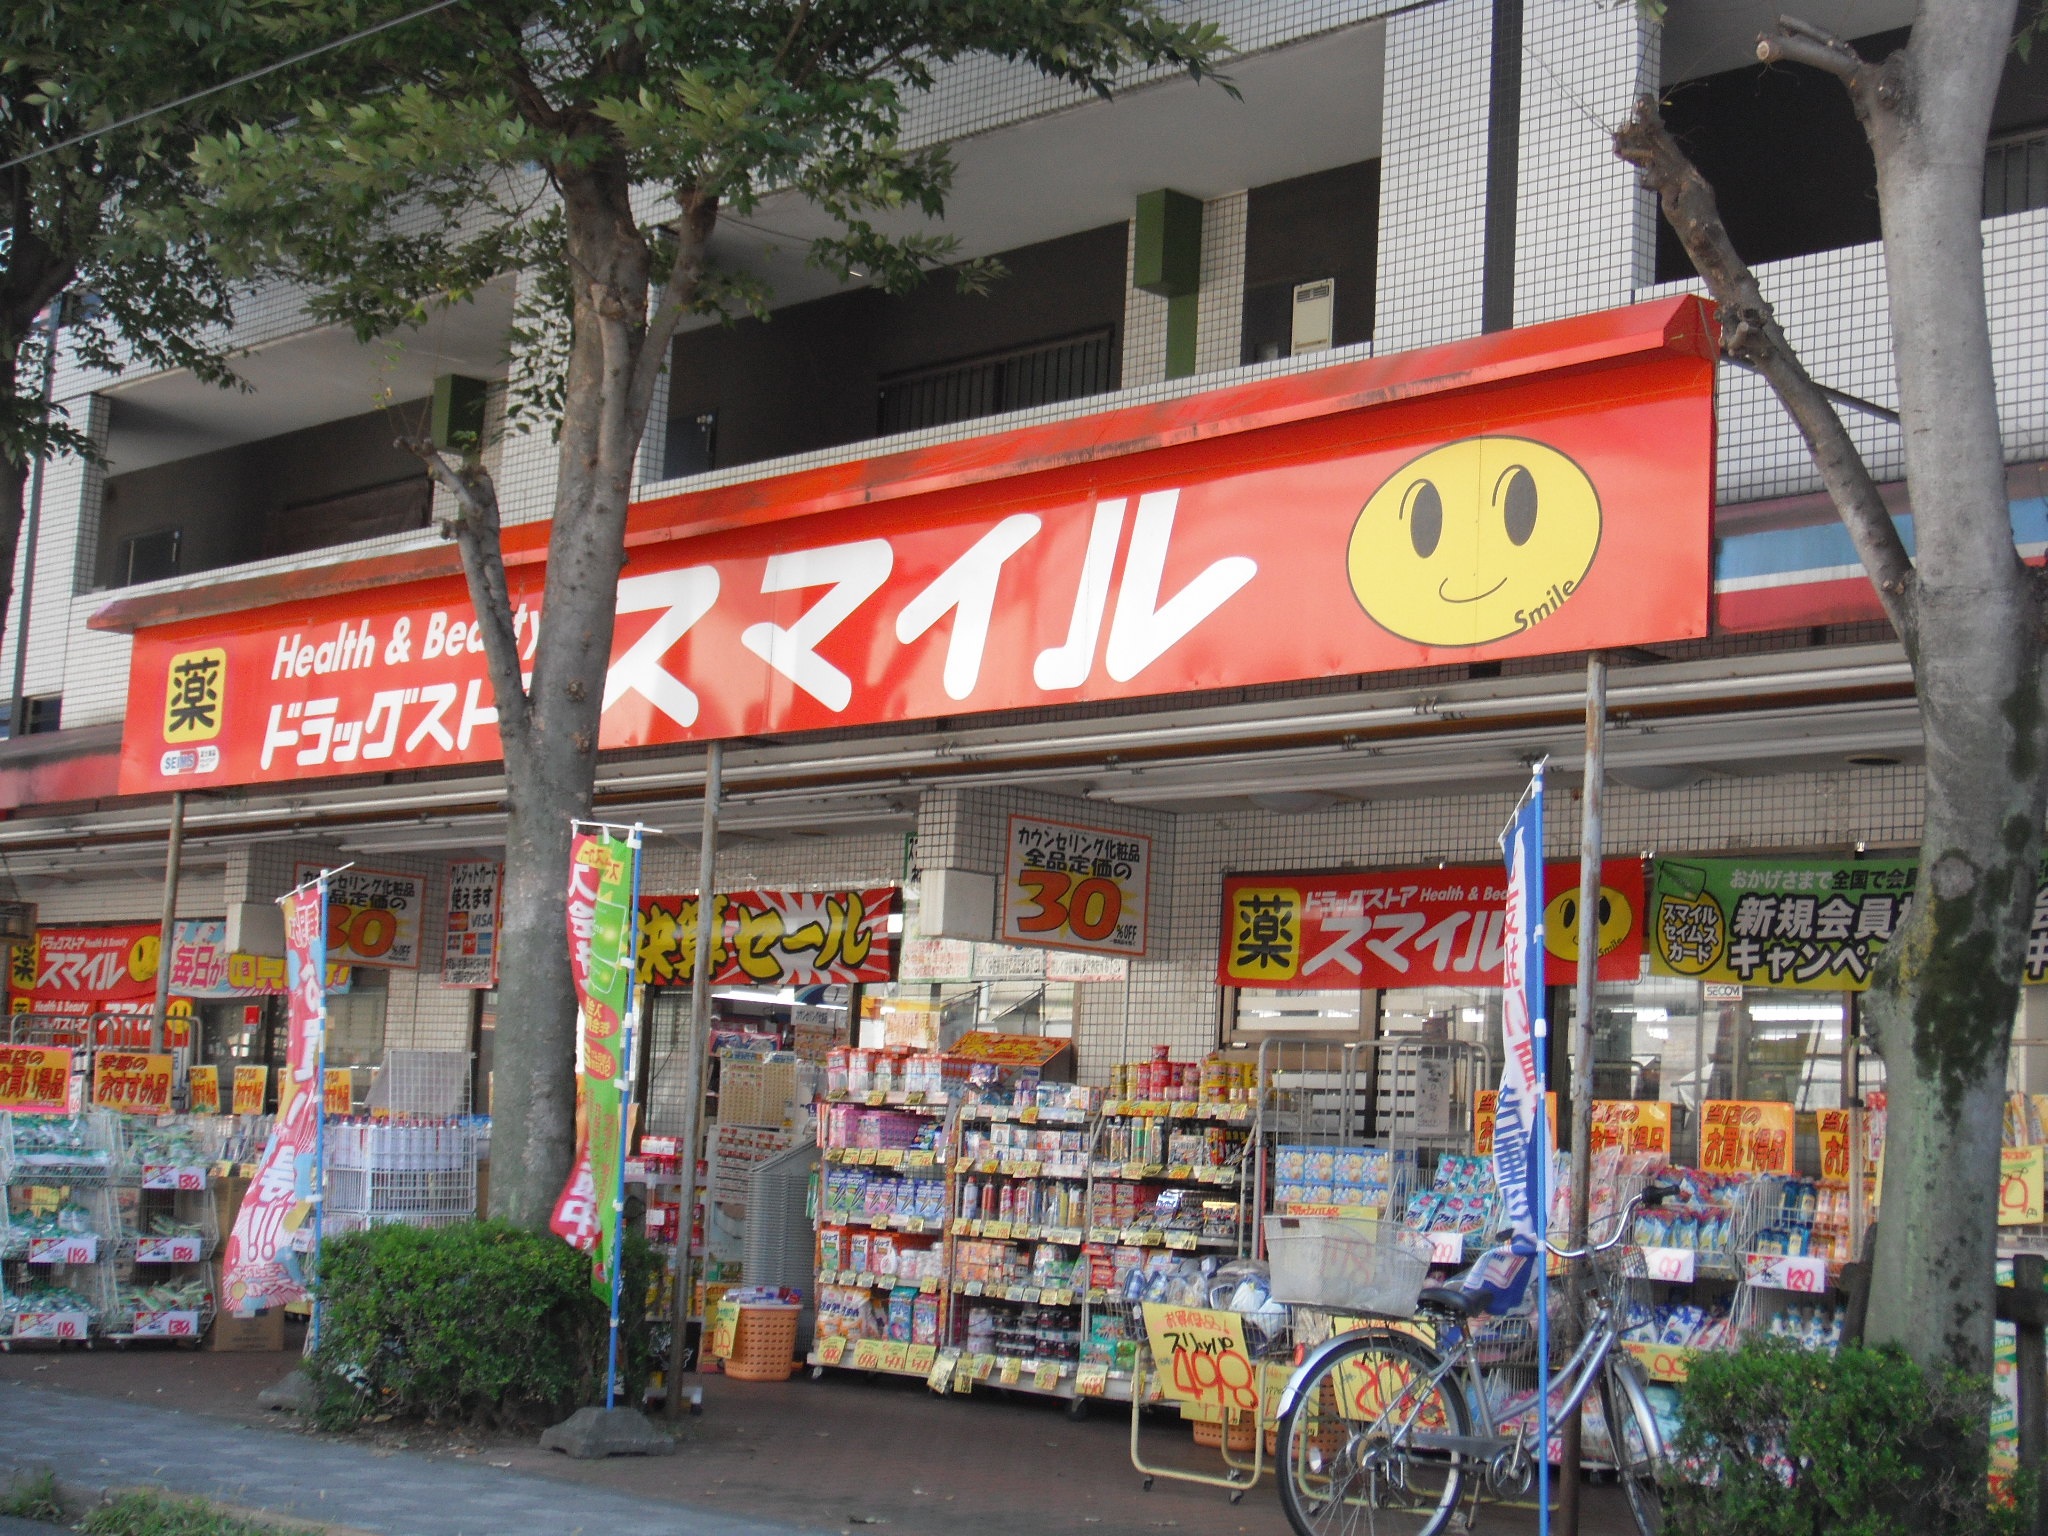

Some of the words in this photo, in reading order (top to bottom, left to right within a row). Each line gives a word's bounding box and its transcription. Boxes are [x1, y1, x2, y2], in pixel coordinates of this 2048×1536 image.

[600, 488, 1259, 730] スマイル
[1513, 577, 1577, 633] Smile
[270, 619, 376, 681] Health
[384, 616, 410, 666] &
[422, 603, 541, 661] Beaty
[168, 656, 221, 733] 薬
[260, 676, 502, 772] ドラッグスト
[1017, 825, 1141, 864] カウンセリング化粧品
[1023, 847, 1132, 881] 全品定価の
[302, 870, 415, 899] カンセリング化粧品
[328, 886, 408, 911] 品定価の
[451, 885, 493, 912] 使えます
[1304, 884, 1419, 912] ドラッグストア
[1419, 886, 1466, 904] Health
[1468, 887, 1479, 901] &
[470, 913, 494, 928] VISA
[1016, 869, 1122, 941] 30
[1663, 902, 1719, 926] スマイル
[41, 936, 85, 950] ドラッグストア
[1116, 923, 1138, 939] %OFF
[1236, 893, 1296, 969] 薬
[1301, 910, 1508, 977] スマイル
[1663, 922, 1720, 947] セイムス
[1669, 942, 1710, 965] カード
[1729, 940, 1876, 981] キャンペ
[37, 952, 127, 990] スマイル
[1706, 985, 1741, 997] SECOM
[99, 1072, 169, 1105] おすすめ品
[1704, 1104, 1761, 1125] 当店の
[1704, 1126, 1788, 1171] お買い得品
[1658, 1256, 1682, 1280] 99
[1786, 1266, 1815, 1293] 129
[1173, 1347, 1260, 1410] 498
